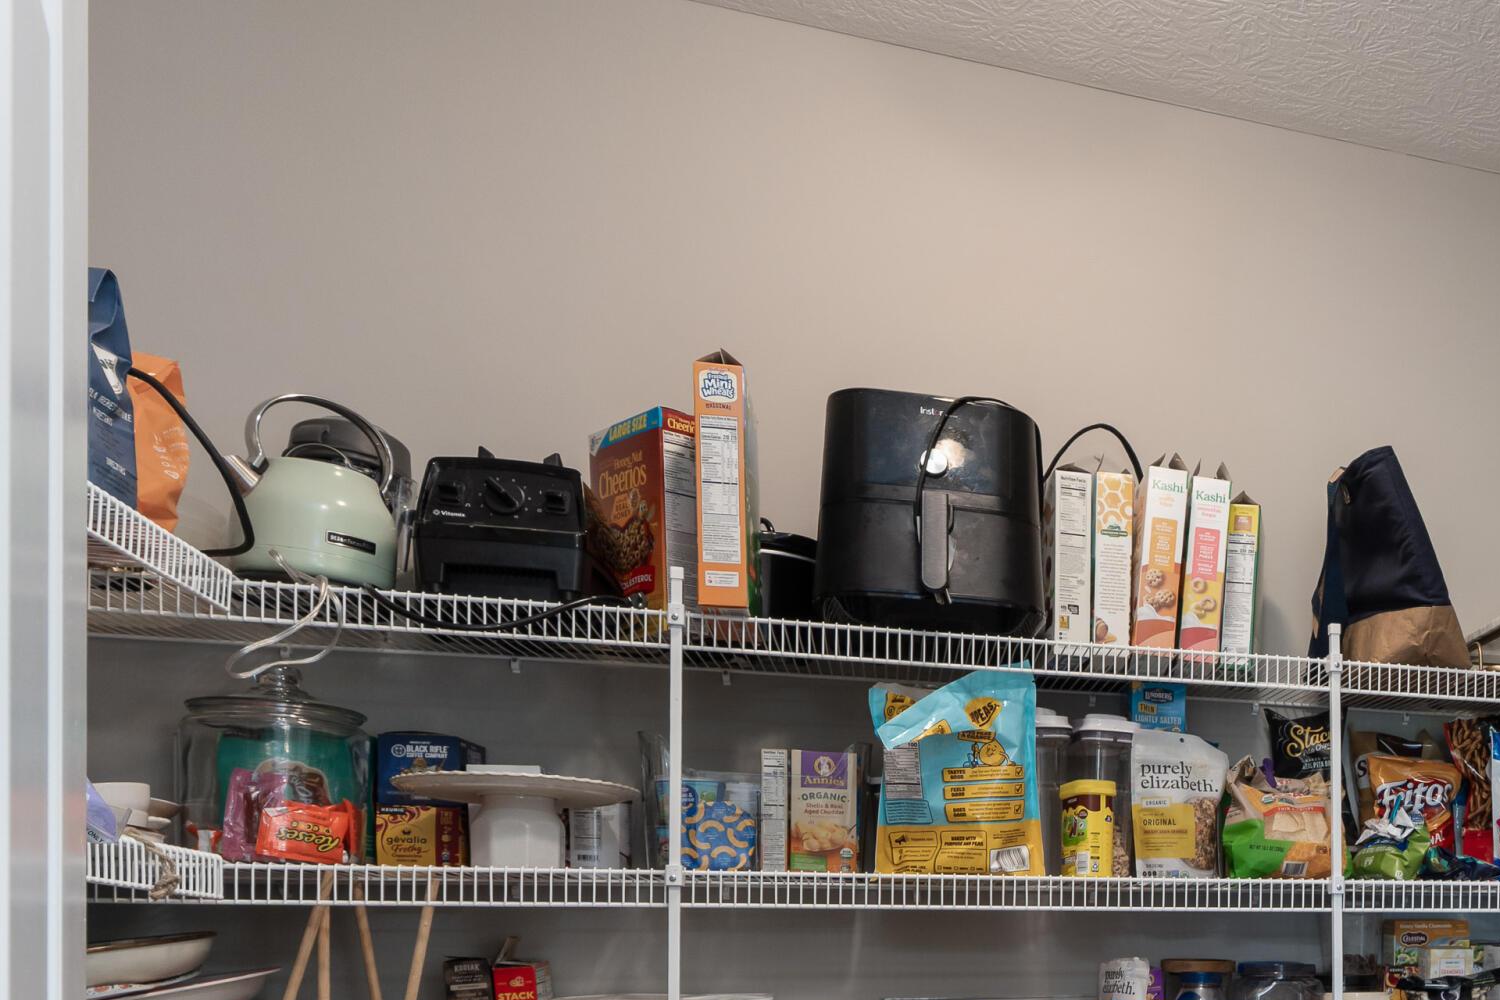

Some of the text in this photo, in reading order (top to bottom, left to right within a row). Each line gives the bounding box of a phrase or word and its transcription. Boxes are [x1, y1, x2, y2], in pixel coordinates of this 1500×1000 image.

[705, 377, 732, 389] Mini
[608, 414, 647, 442] LARGE SIZE
[667, 417, 695, 434] Cheeri
[599, 464, 647, 499] Cheerios
[1152, 479, 1185, 493] Kashi
[1195, 490, 1226, 504] Kashi
[441, 510, 466, 518] Vitamix
[622, 573, 653, 590] OLESTEROL
[1138, 703, 1156, 713] THIN
[1135, 715, 1182, 726] LIGHTLY SALTED
[1286, 724, 1331, 757] Stac
[406, 744, 449, 754] BLACK RIFLE
[1140, 761, 1193, 777] purely
[804, 776, 845, 787] Annie's
[1140, 775, 1219, 793] elizabeth.
[802, 791, 848, 803] ORGANIC
[1376, 778, 1452, 815] Fritos
[1142, 818, 1177, 826] ORIGINAL
[276, 827, 340, 853] Reese's
